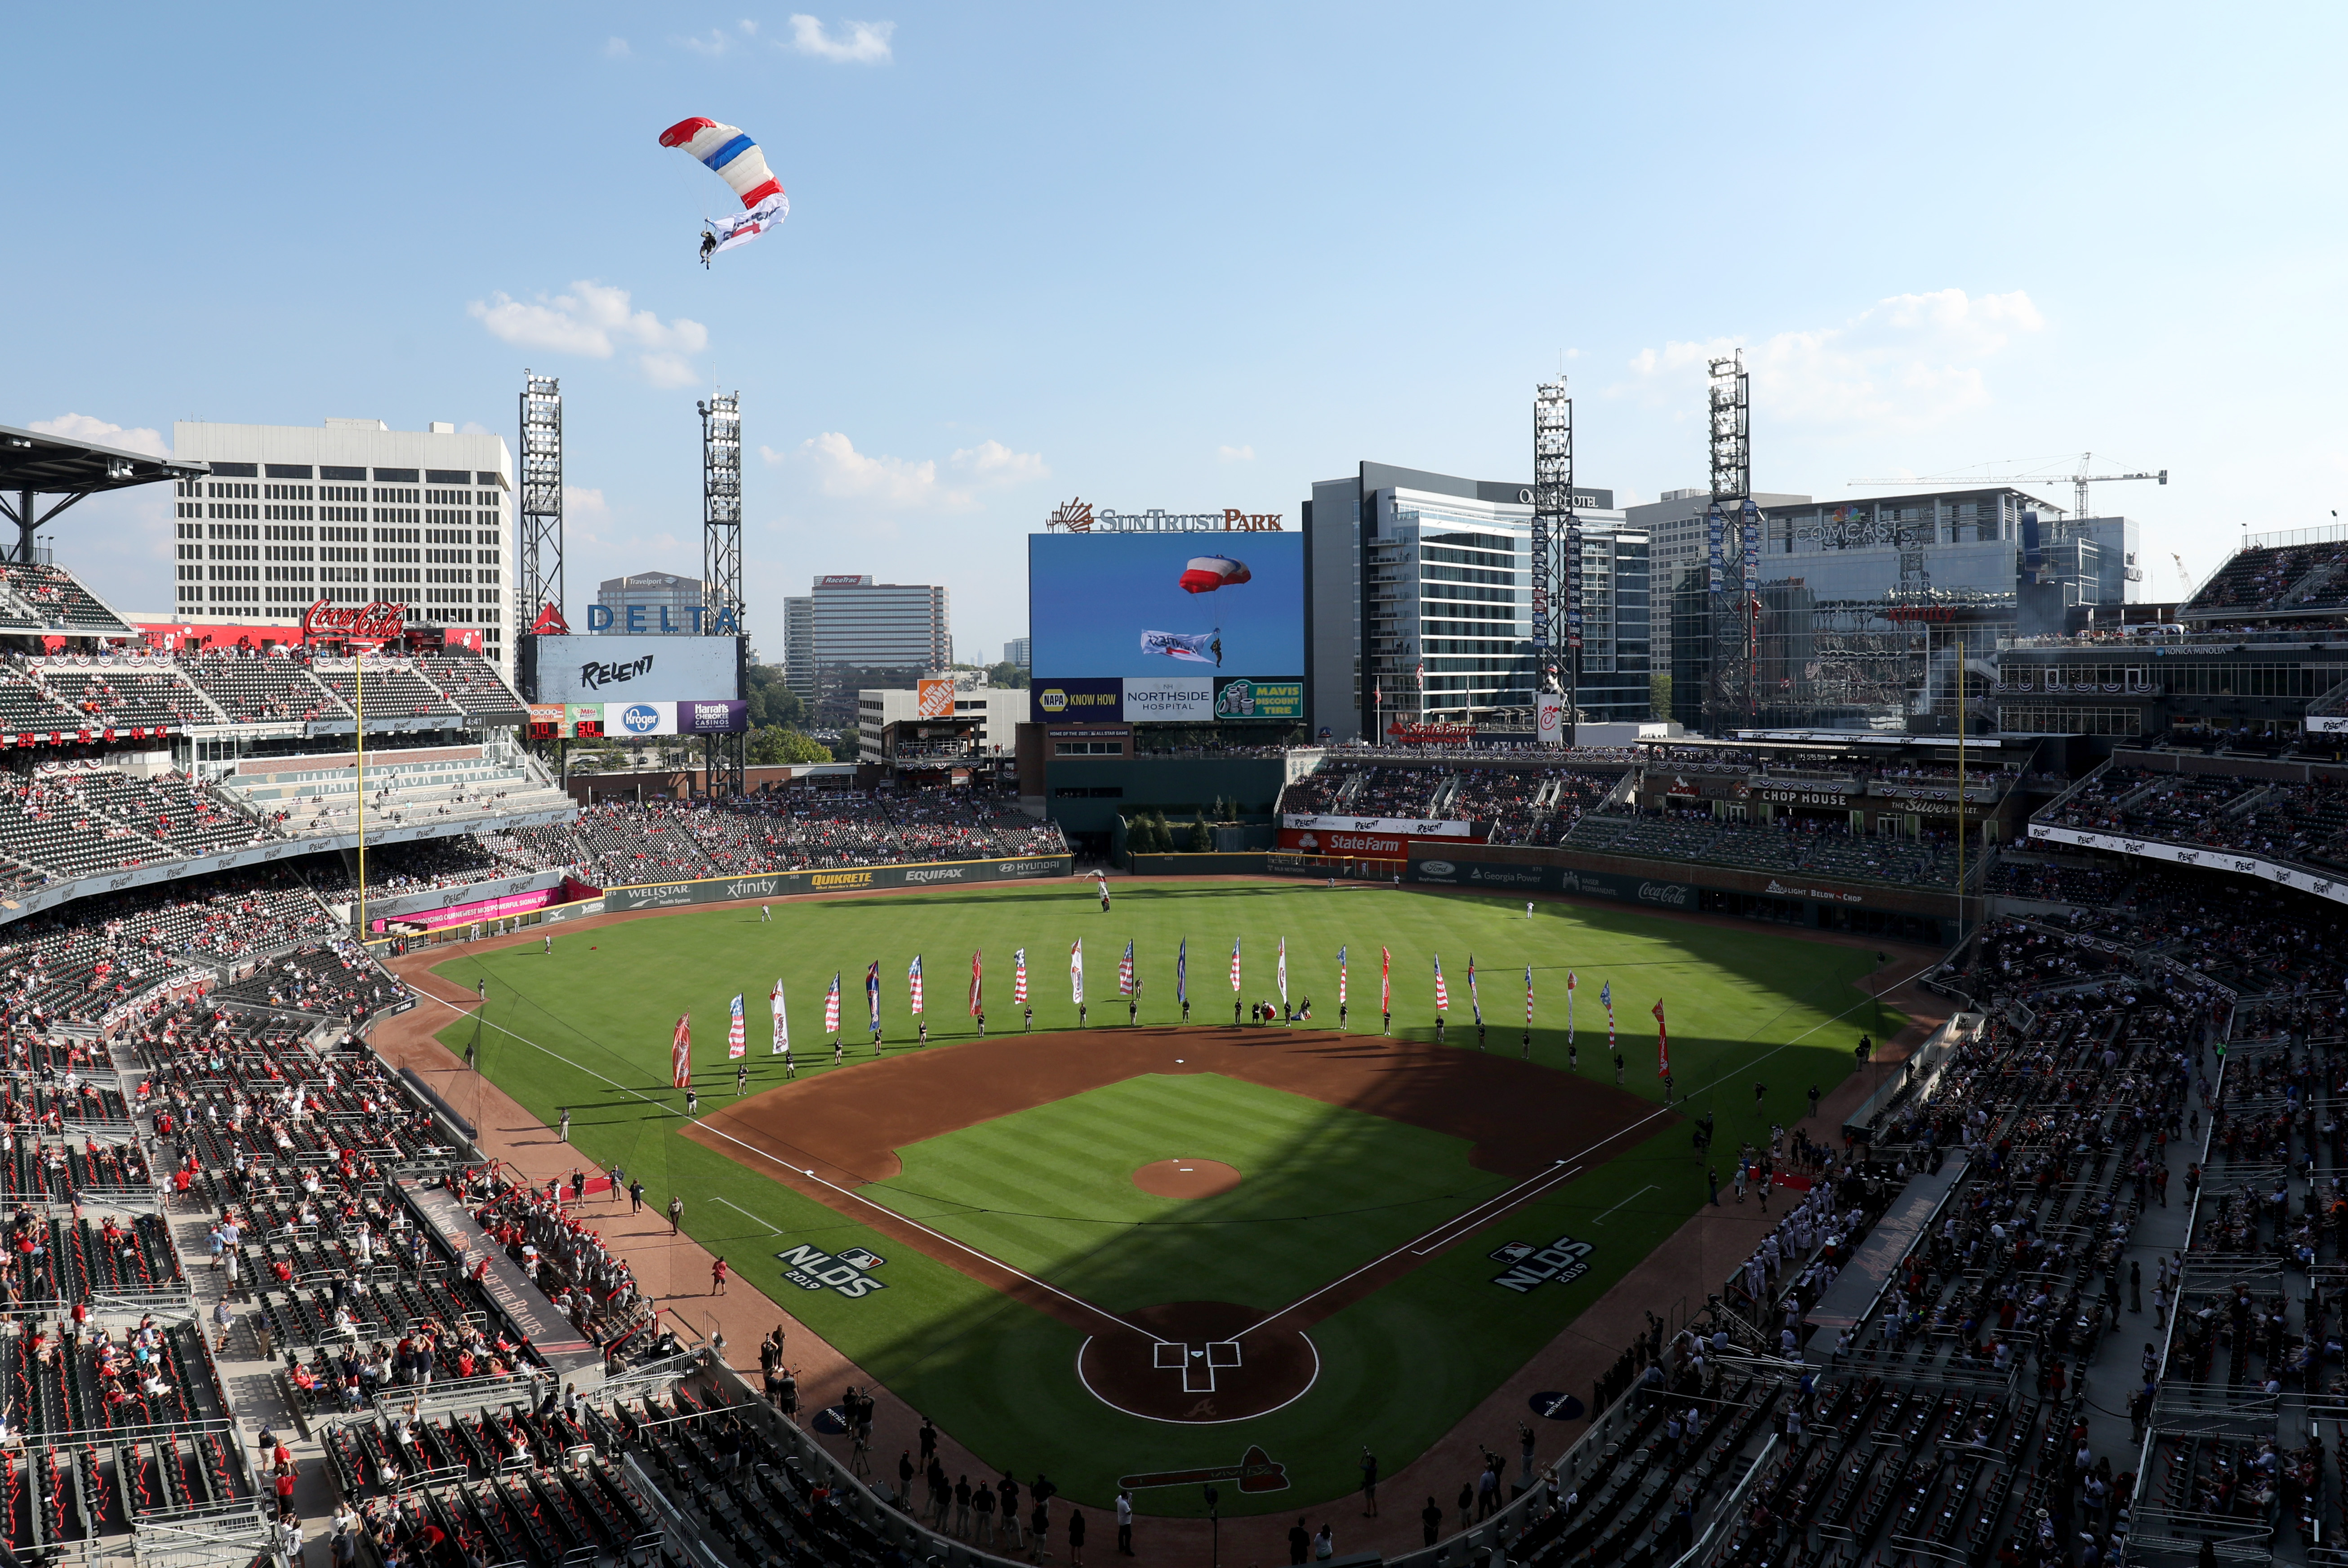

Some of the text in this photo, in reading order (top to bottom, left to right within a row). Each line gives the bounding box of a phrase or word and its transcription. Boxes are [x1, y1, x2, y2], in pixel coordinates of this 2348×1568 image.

[1796, 520, 1900, 542] COMCAST
[629, 578, 662, 586] Travelport
[588, 605, 740, 632] DELTA
[1887, 603, 1956, 625] xfinity
[581, 655, 654, 690] RELENT
[918, 680, 954, 716] HOME
[922, 683, 936, 698] THE
[1127, 692, 1209, 701] NORTHSIDE
[1256, 687, 1300, 696] MAVIS
[932, 692, 954, 716] DEPOT
[1044, 694, 1116, 705] NAPA KNOW HOW
[695, 704, 729, 714] Harrah's
[1263, 706, 1292, 714] TIRE
[532, 722, 549, 734] 70
[578, 721, 595, 733] 50
[626, 709, 657, 731] Kroger
[18, 724, 194, 747] 29 31 35 41 44 47 42
[1700, 787, 1728, 797] LIGHT
[1763, 791, 1796, 802] CHOP
[1802, 793, 1846, 805] HOUSE
[1905, 797, 1952, 814] Silver
[1295, 818, 1443, 834] RELENT RELENT RELENT
[1331, 835, 1399, 851] StateFarm
[110, 816, 527, 891] RELENT RELENT RELENT RELENT RELENT RELENT RELENT
[1017, 861, 1059, 870] HYUNDAI
[1426, 862, 1448, 873] Ford
[811, 872, 873, 886] QUIKRETE
[905, 868, 962, 882] EQUIFAX
[1484, 872, 1542, 882] Georgia Power
[442, 877, 535, 908] RELENT RELENT
[628, 884, 689, 898] WELLSTAR
[727, 878, 777, 898] xfinity
[1582, 885, 1617, 896] PERMANENTE
[1788, 888, 1806, 896] LIGHT
[444, 912, 456, 920] OUR
[456, 908, 477, 918] NEWEST
[477, 905, 493, 915] MOST
[491, 901, 519, 911] POWERFUL
[778, 1244, 883, 1297] NLDS
[1494, 1238, 1593, 1292] NLDS
[1555, 1263, 1588, 1283] 2019
[785, 1270, 821, 1290] 2019
[494, 1284, 546, 1337] THE BRAVES
[1183, 1399, 1217, 1417] A
[1544, 1394, 1569, 1417] POSTSEASON
